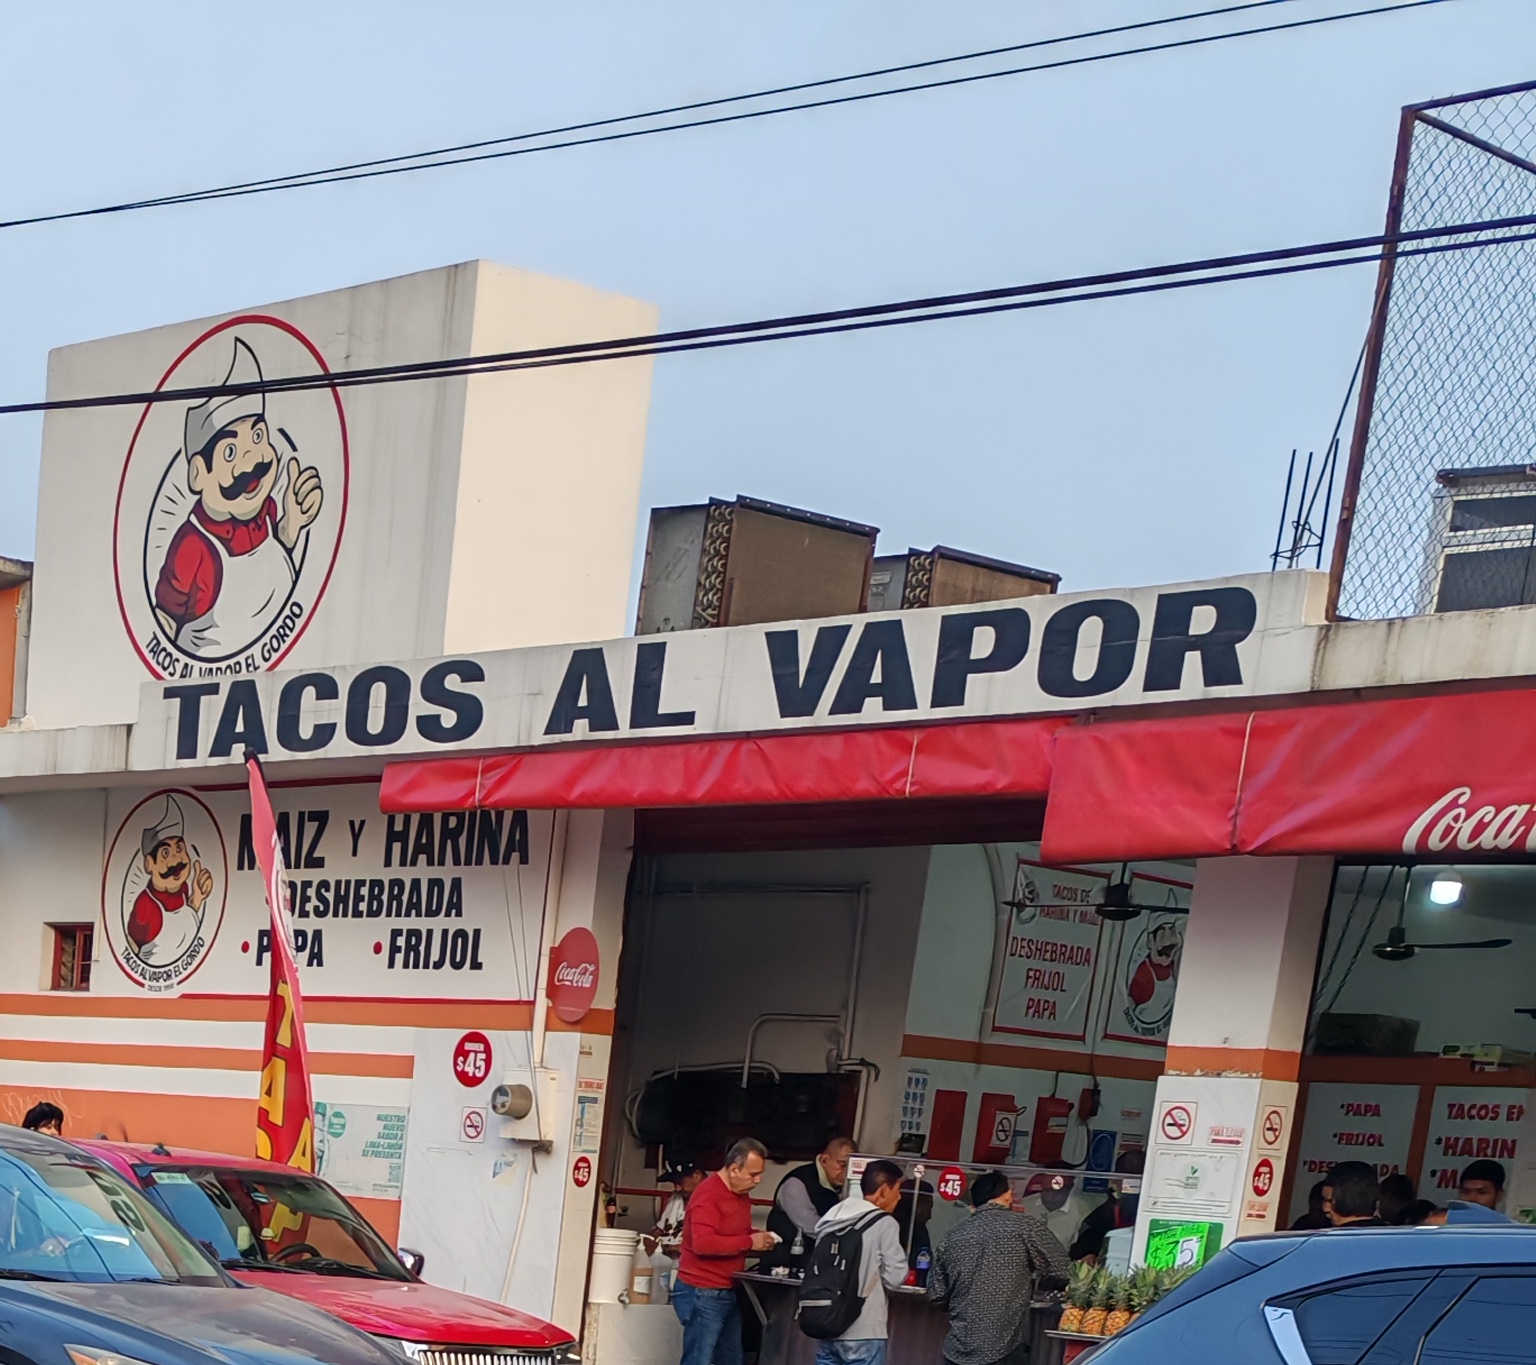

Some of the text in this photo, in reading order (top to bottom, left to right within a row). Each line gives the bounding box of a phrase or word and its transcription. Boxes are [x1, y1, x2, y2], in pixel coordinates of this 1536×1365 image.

[145, 631, 180, 677] TACOS
[261, 601, 303, 663] GORDO
[163, 586, 1258, 762] TACOS AL VAPOR
[348, 819, 366, 857] Y
[384, 809, 530, 868] HARINA
[121, 946, 141, 974] TACOS
[181, 936, 205, 971] GORDO
[256, 928, 324, 967] PPA
[388, 928, 483, 971] FRIJOL
[1009, 935, 1092, 968] DESHEBRADA
[1024, 967, 1067, 993] FRIJOL
[1024, 997, 1057, 1021] PAPA
[456, 1051, 487, 1078] $45
[1447, 1102, 1500, 1122] TACOS
[940, 1179, 962, 1197] $45
